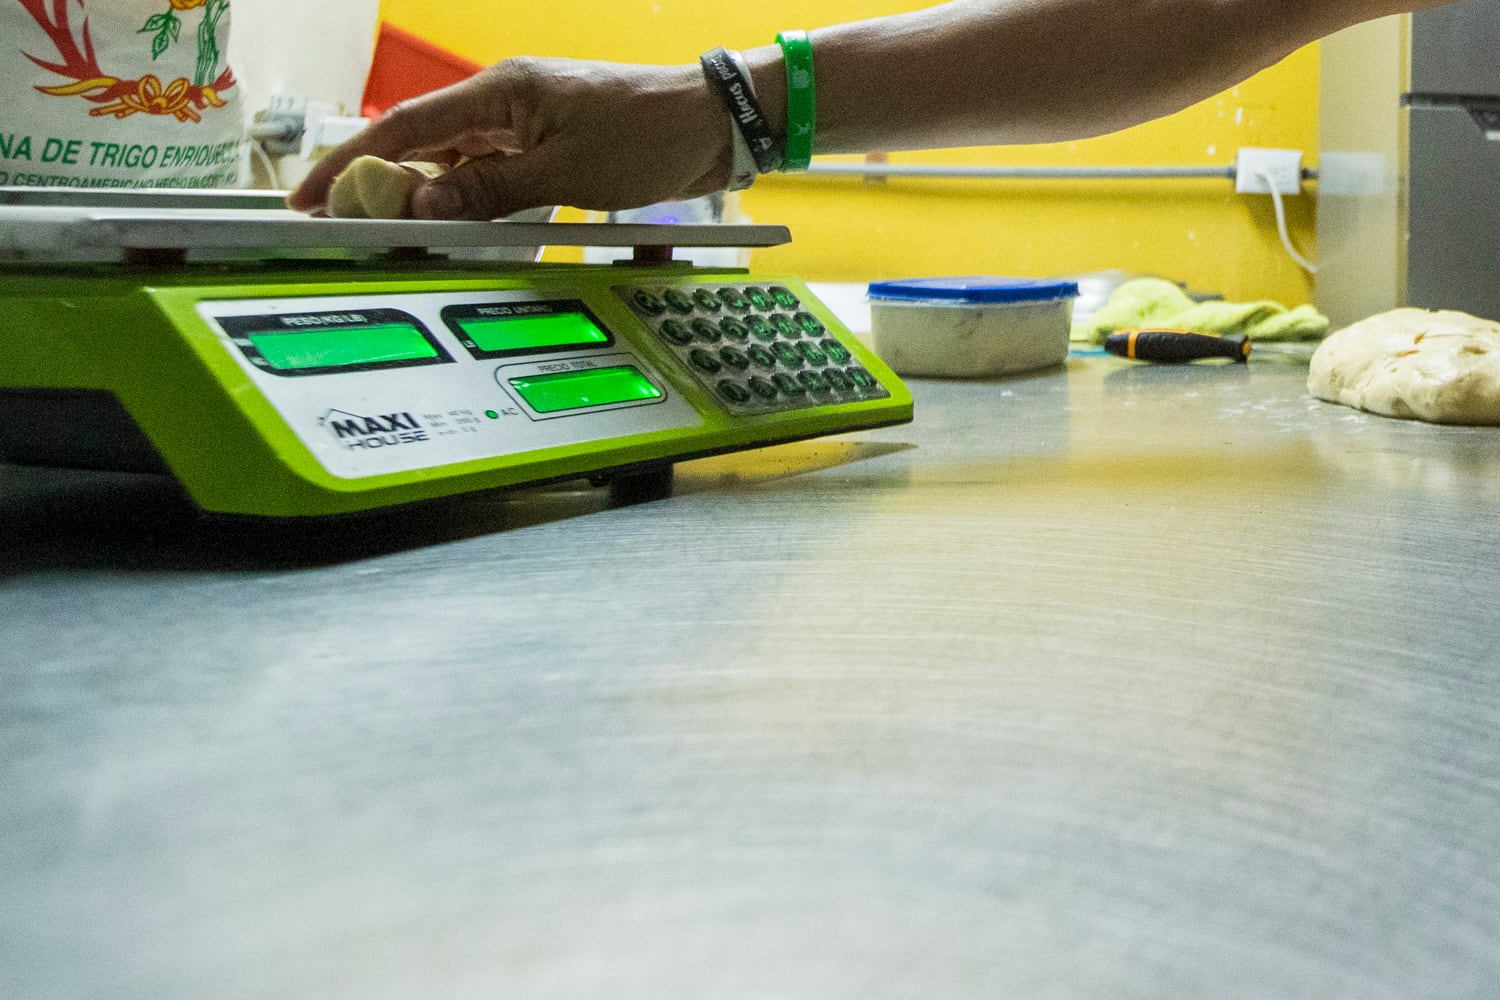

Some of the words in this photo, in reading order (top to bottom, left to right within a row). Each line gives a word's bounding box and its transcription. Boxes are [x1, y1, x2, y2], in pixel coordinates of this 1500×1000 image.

[730, 82, 759, 124] Hocus
[41, 138, 82, 165] DE
[89, 141, 158, 168] TRIGO
[537, 362, 570, 374] PRECIO
[502, 407, 519, 417] AC
[331, 412, 420, 439] MAXI
[345, 430, 430, 450] HOUSE
